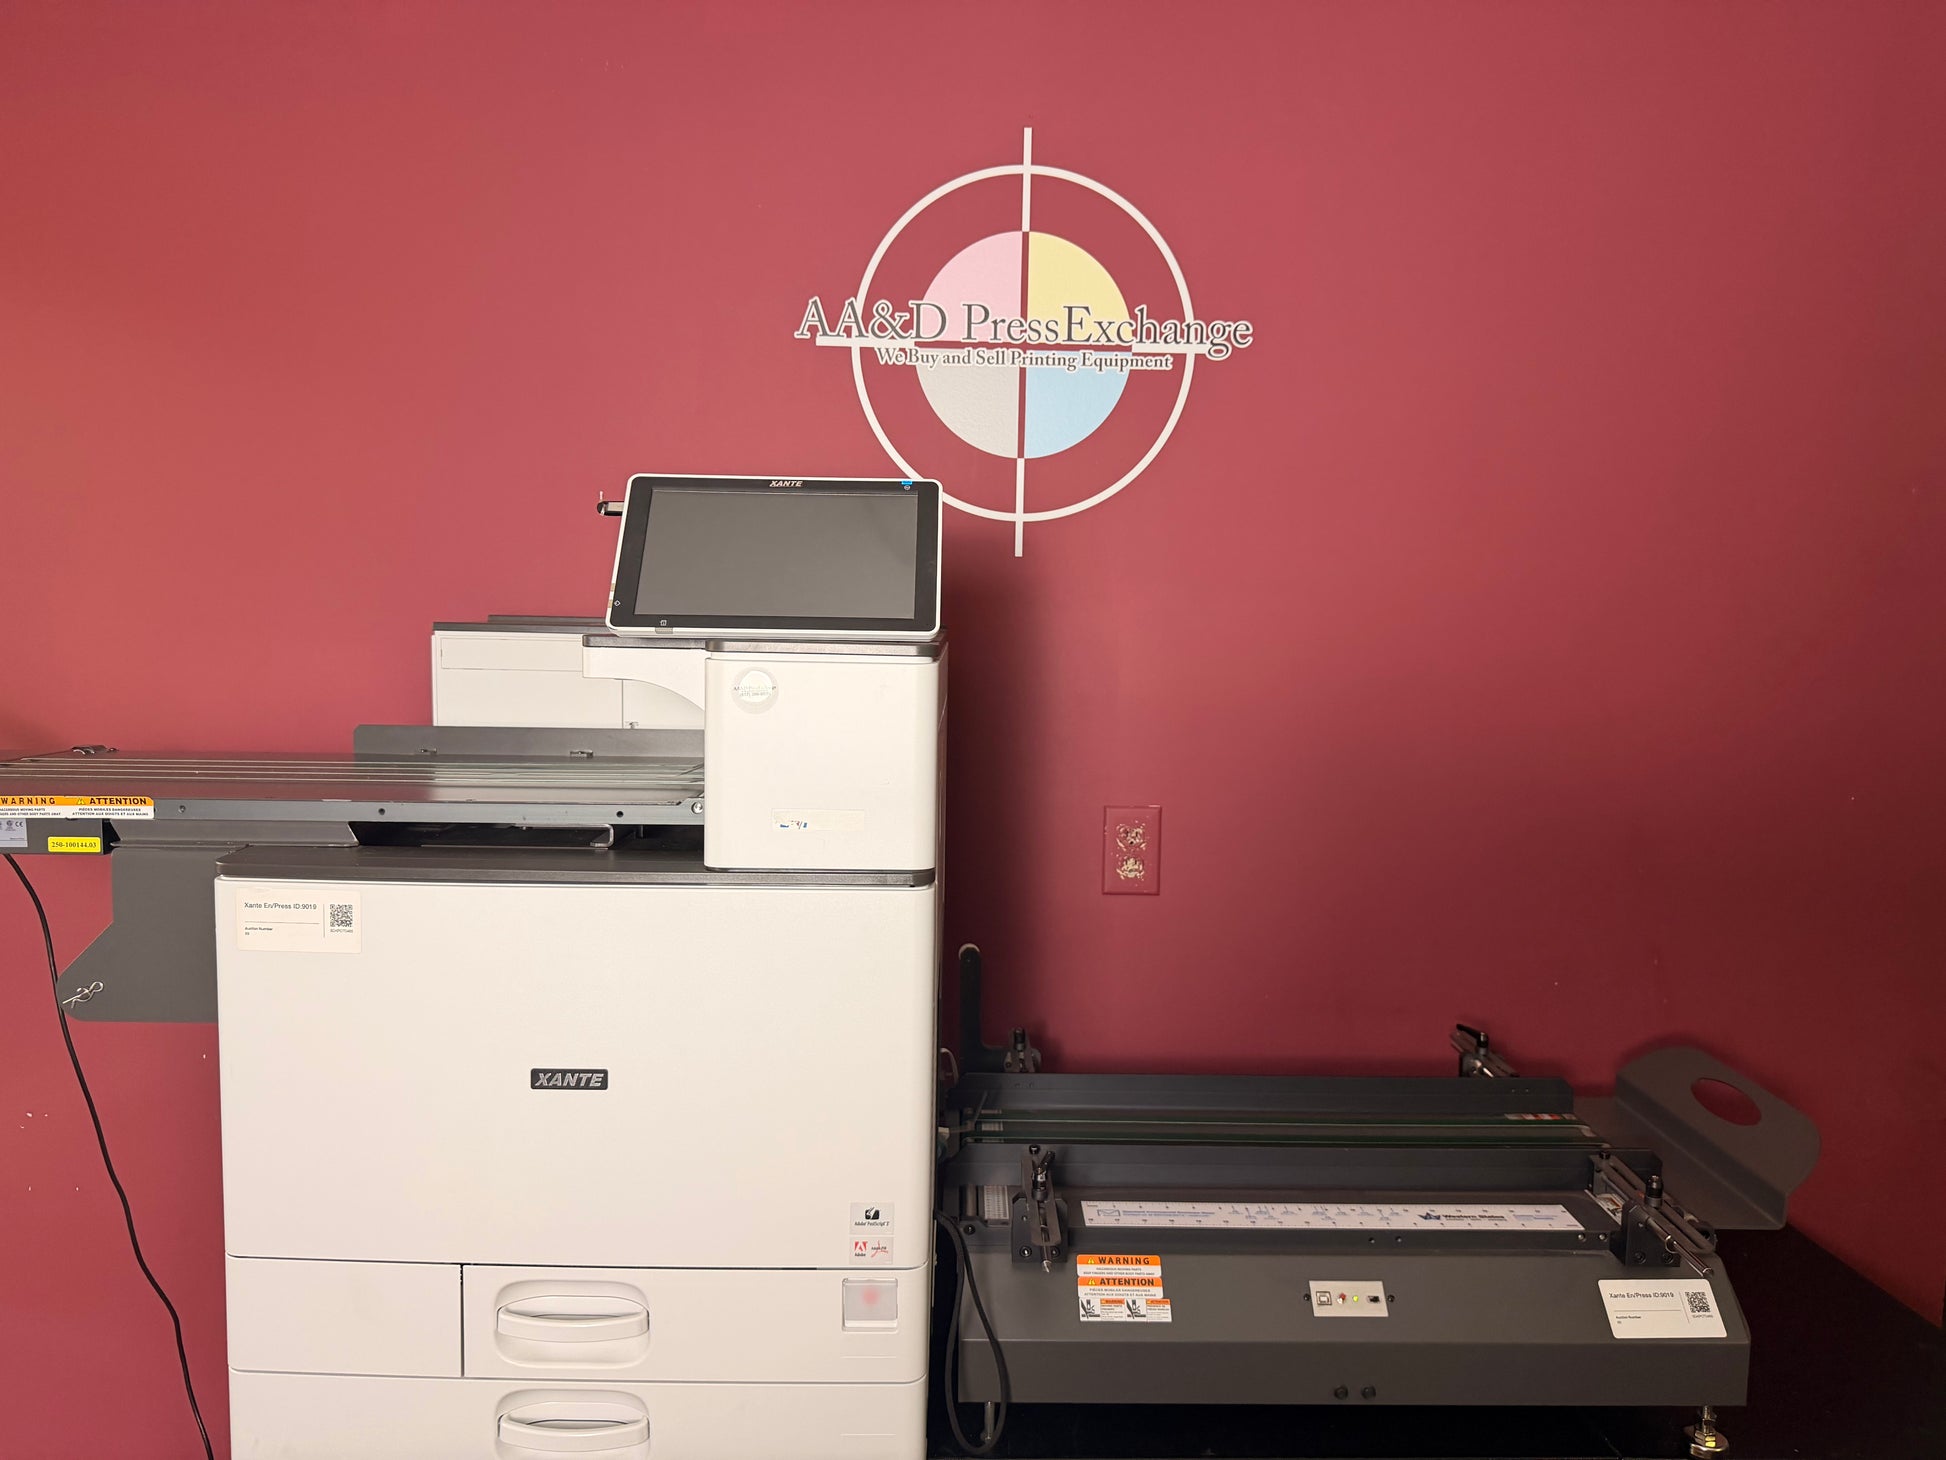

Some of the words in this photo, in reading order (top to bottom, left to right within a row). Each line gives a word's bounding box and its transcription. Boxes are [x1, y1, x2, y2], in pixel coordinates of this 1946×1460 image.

[795, 298, 947, 340] AA&D
[961, 302, 1251, 359] PressExchange
[876, 347, 905, 363] We
[907, 348, 940, 369] Buy
[942, 349, 972, 365] and
[975, 350, 1006, 366] Sell
[1010, 350, 1078, 371] Printing
[1081, 352, 1172, 373] Equipment
[0, 797, 55, 805] WARNING
[89, 797, 147, 805] ATTENTION
[534, 1072, 605, 1087] XANTE
[1098, 1256, 1150, 1265] WARNING
[1100, 1277, 1154, 1286] ATTENTION
